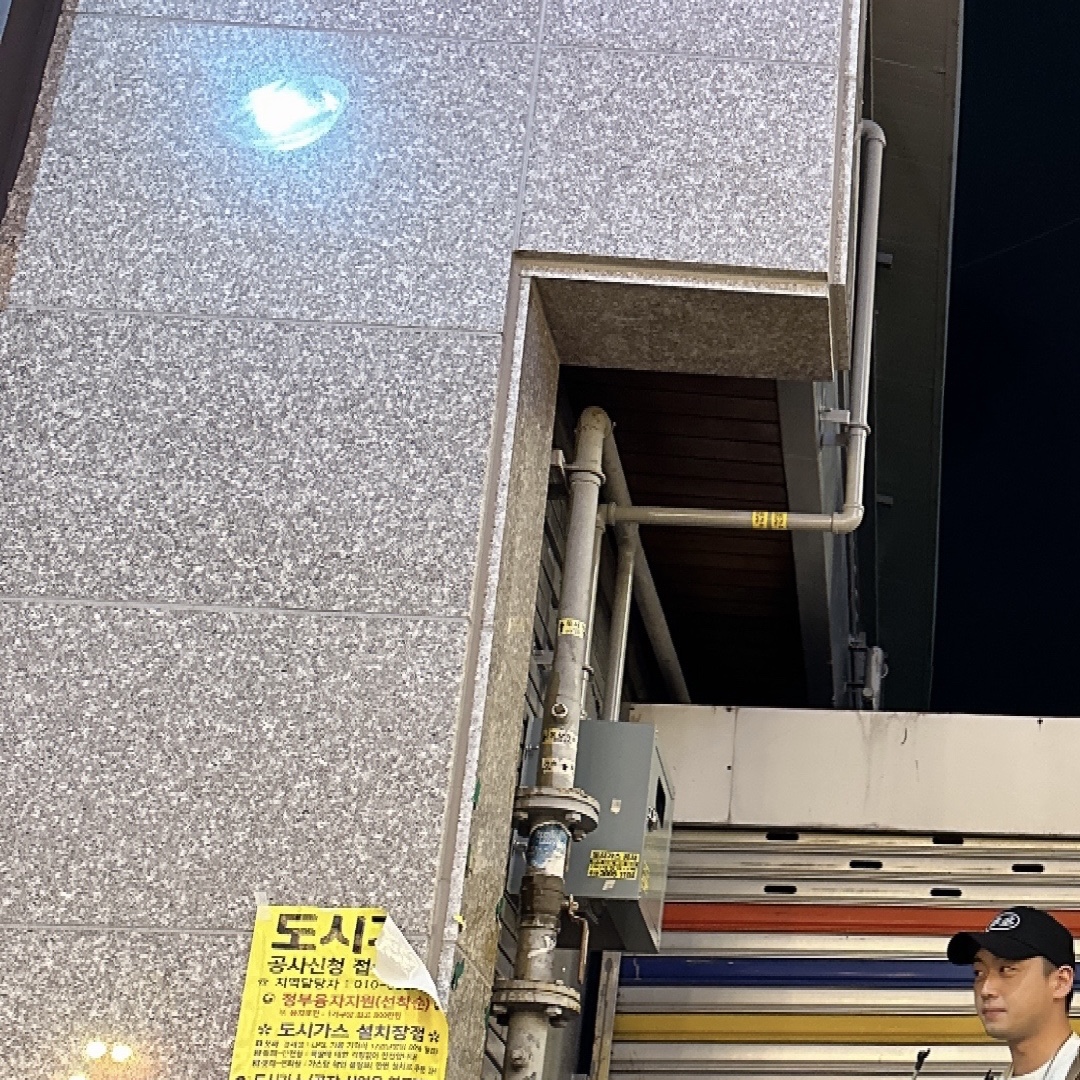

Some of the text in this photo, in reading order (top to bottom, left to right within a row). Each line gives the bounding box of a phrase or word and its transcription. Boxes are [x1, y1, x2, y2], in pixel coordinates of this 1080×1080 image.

[267, 955, 376, 976] 공사신청 접
[277, 1023, 349, 1039] 도시가스
